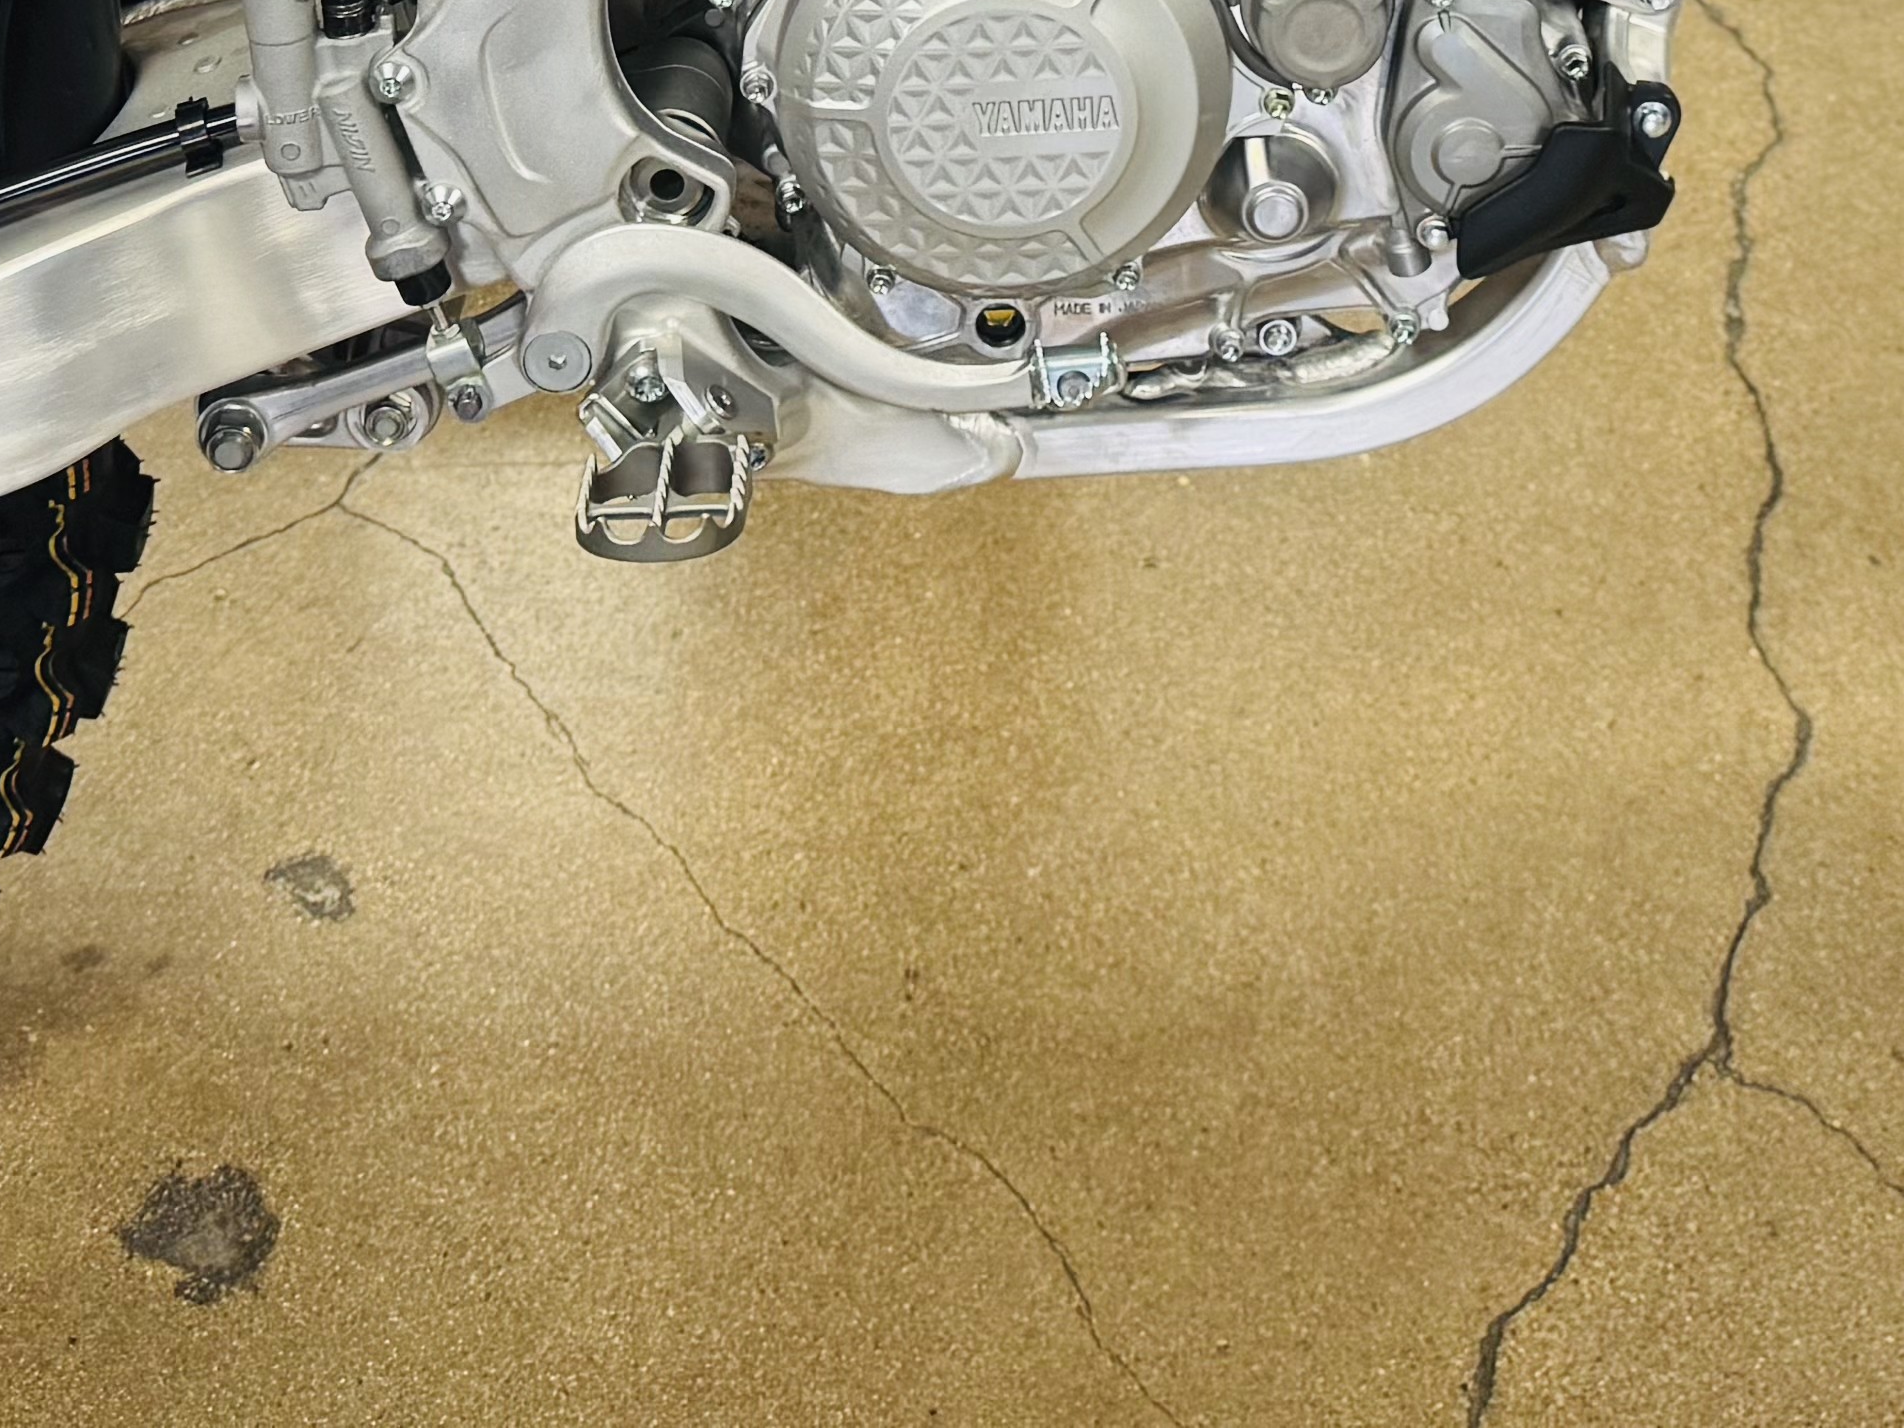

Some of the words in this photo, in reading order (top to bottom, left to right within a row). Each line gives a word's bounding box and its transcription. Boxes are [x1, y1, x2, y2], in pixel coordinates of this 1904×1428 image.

[264, 103, 322, 126] LOWER
[971, 95, 1120, 137] YAMAHA
[1053, 302, 1092, 316] MADE
[1099, 302, 1111, 314] IN
